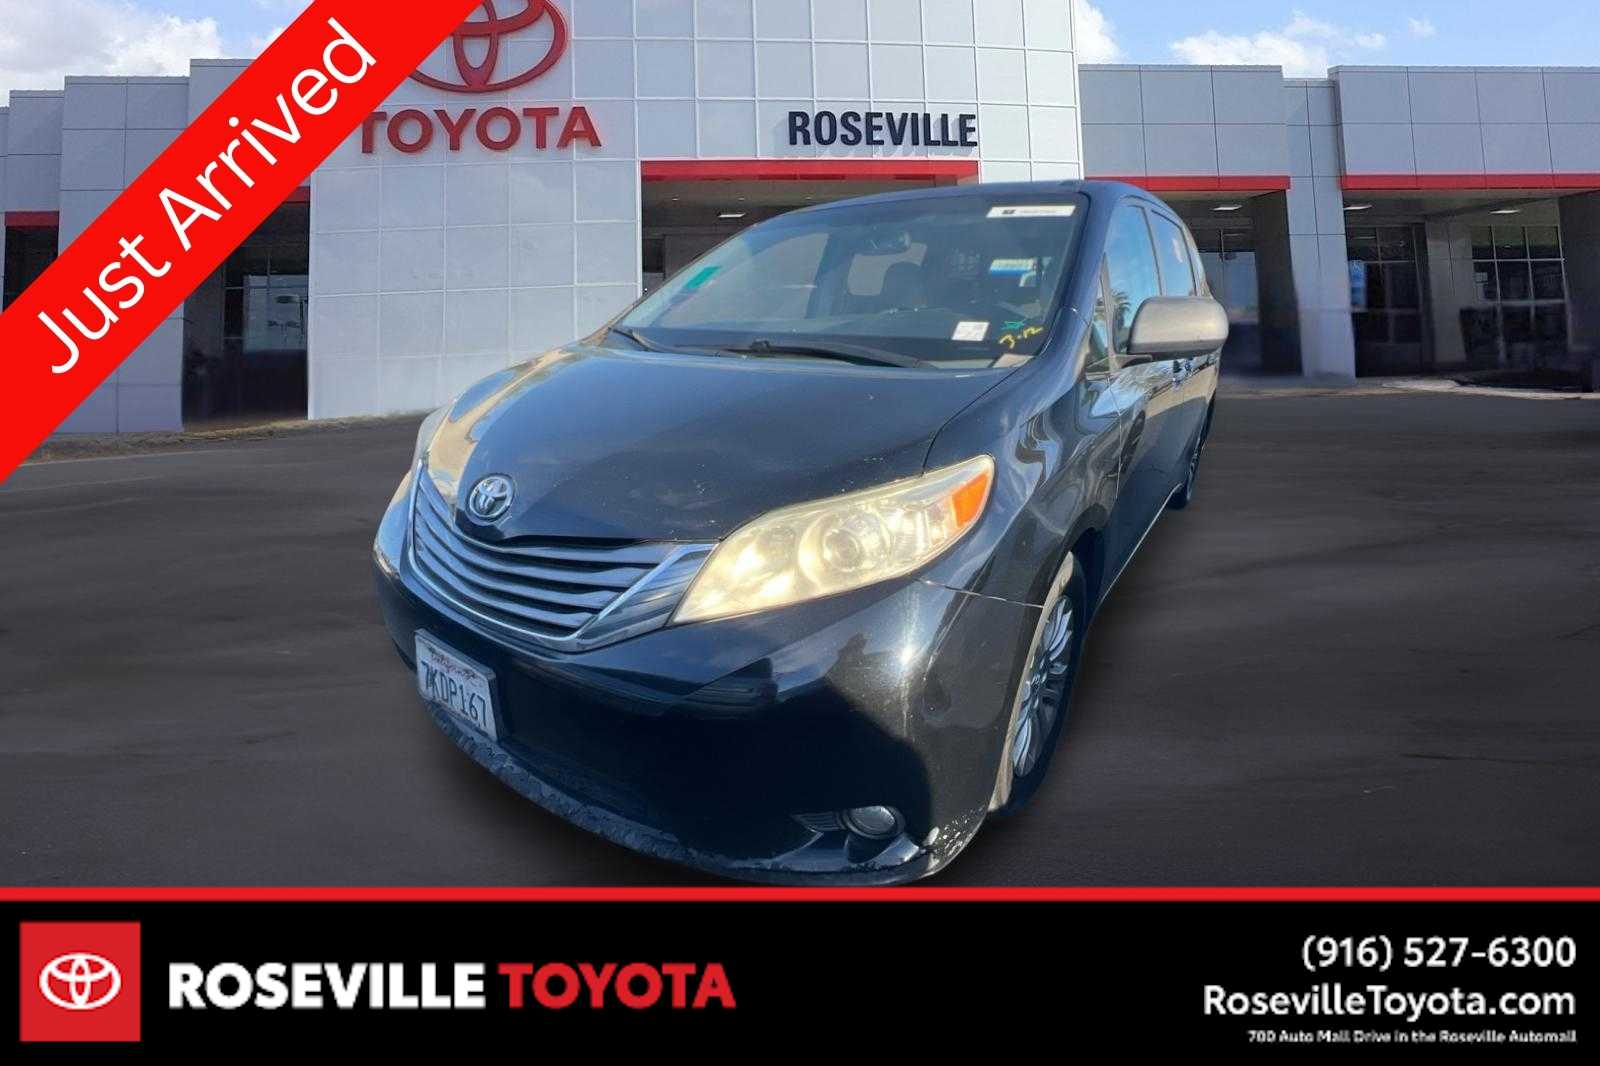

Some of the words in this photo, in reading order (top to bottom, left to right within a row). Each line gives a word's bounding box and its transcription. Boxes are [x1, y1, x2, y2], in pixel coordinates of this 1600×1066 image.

[361, 106, 602, 154] TOYOTA
[788, 110, 978, 147] ROSEVILLE
[420, 660, 487, 727] 7KDP167
